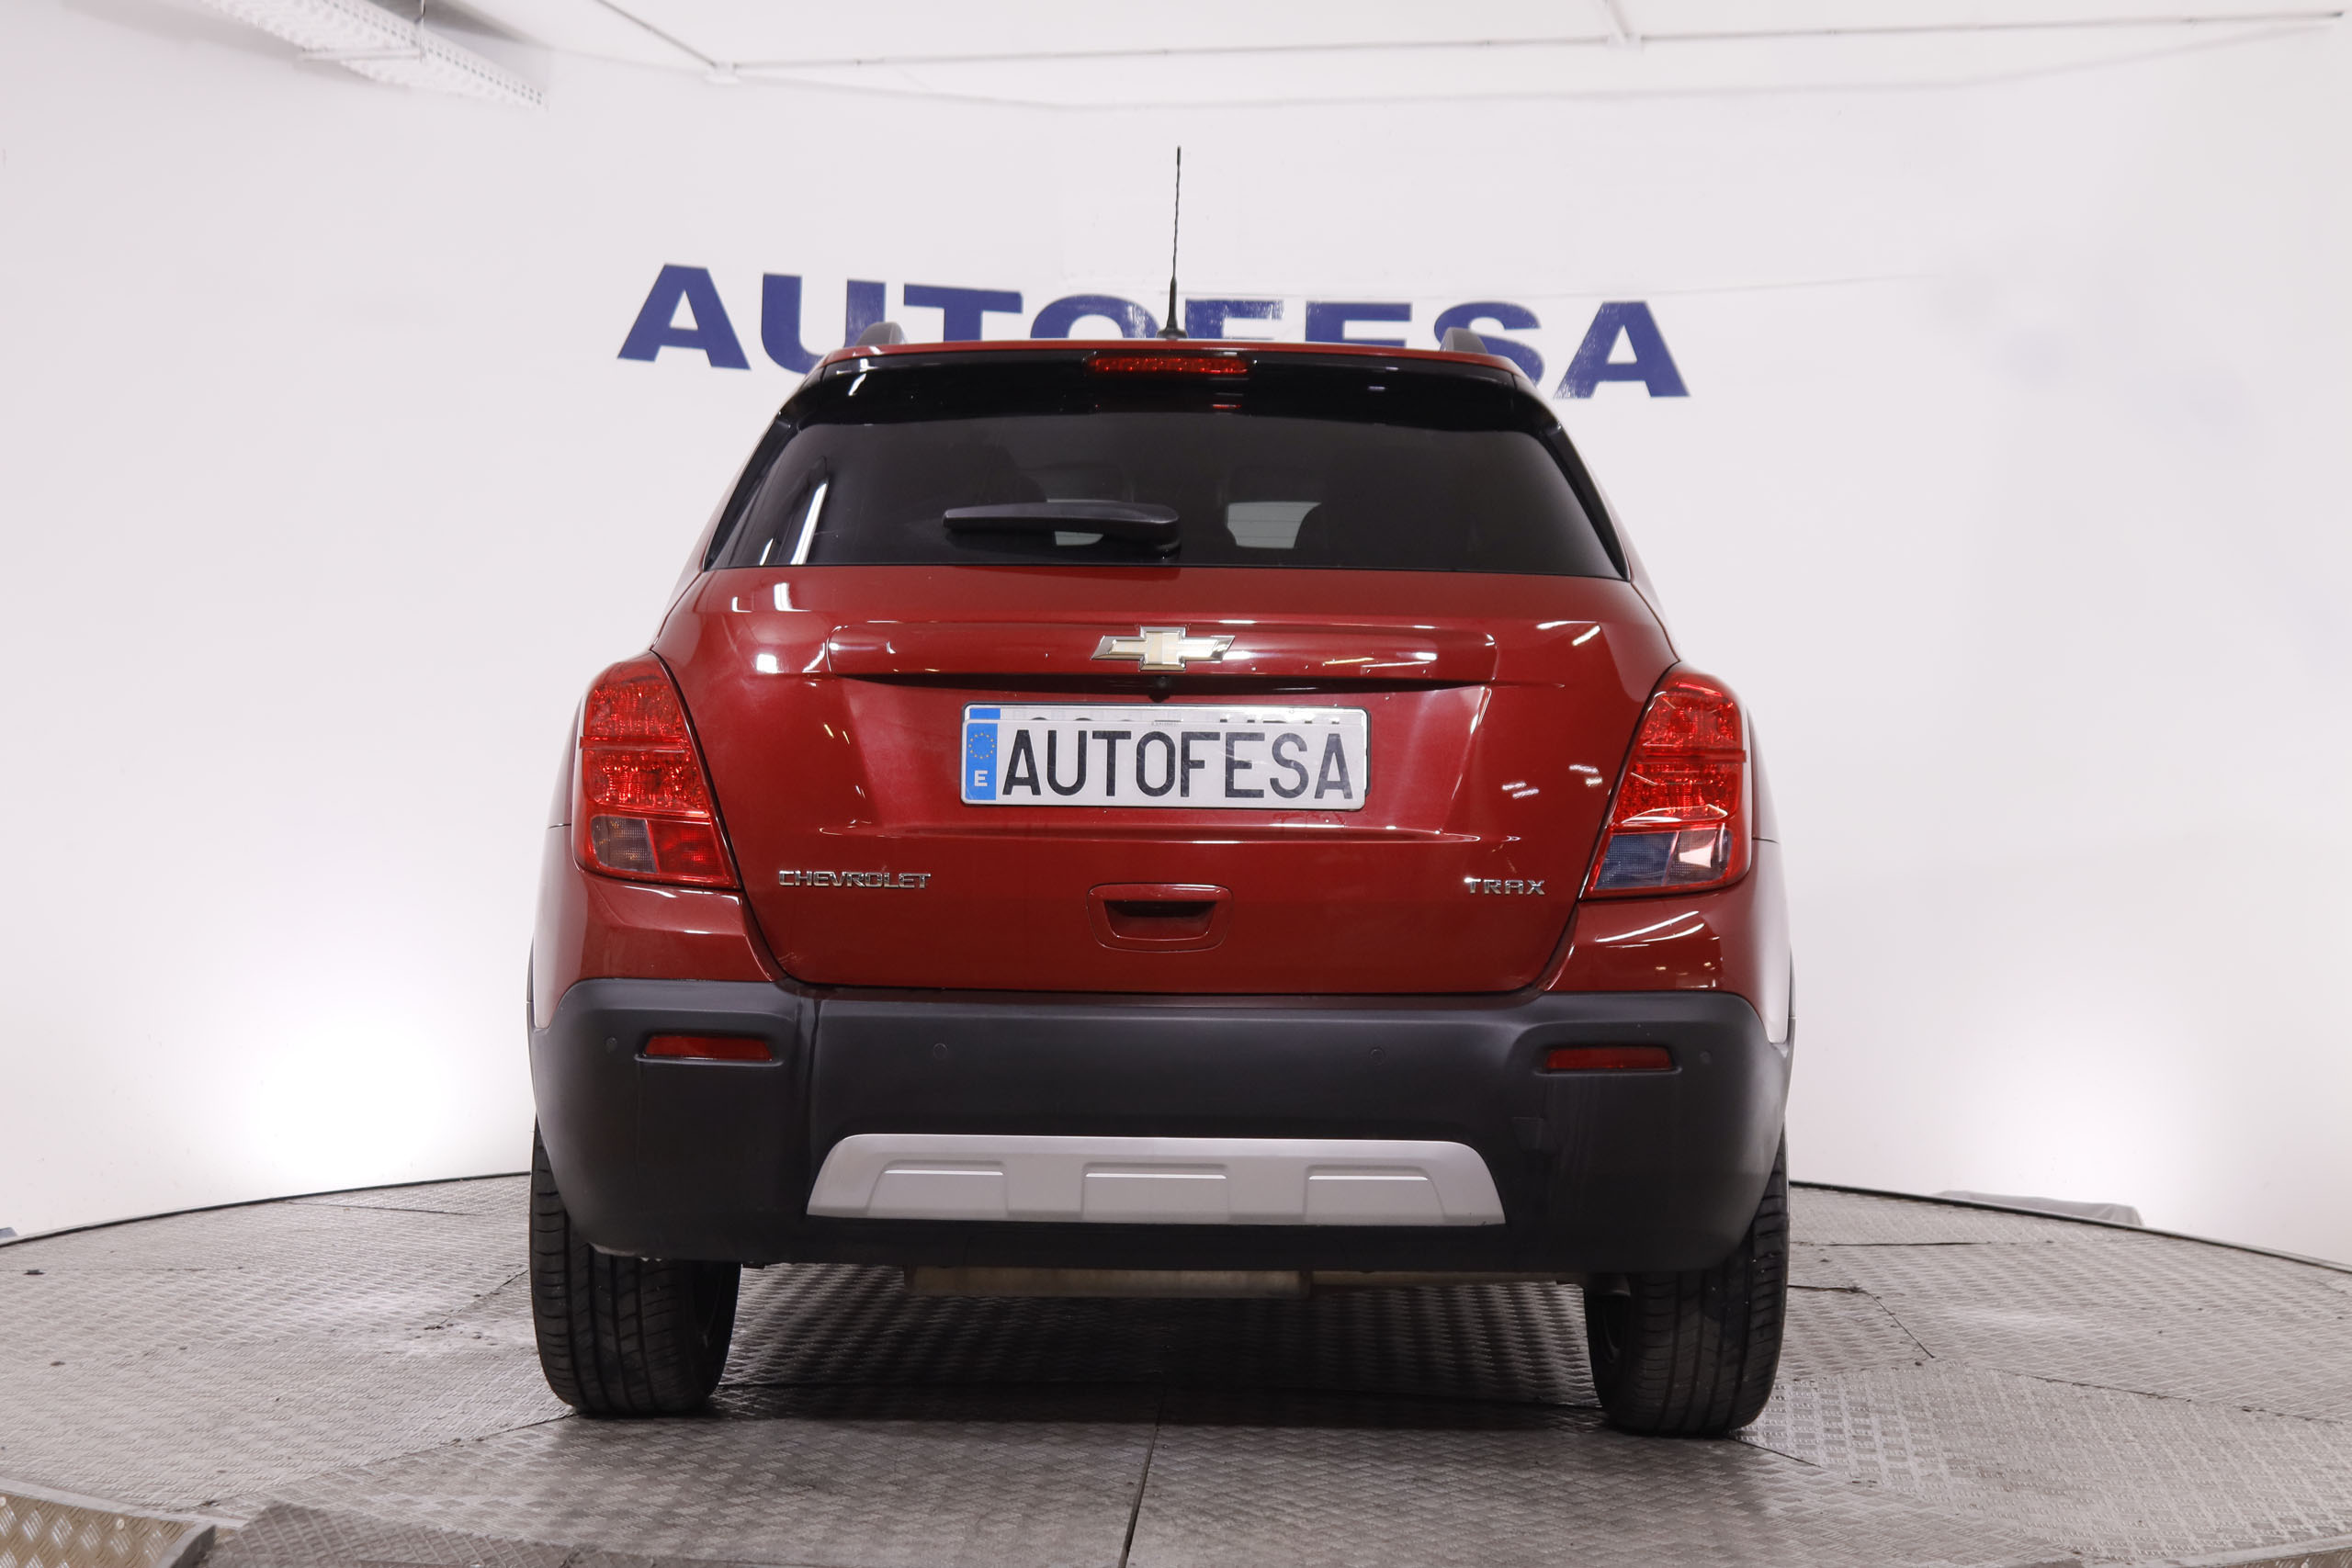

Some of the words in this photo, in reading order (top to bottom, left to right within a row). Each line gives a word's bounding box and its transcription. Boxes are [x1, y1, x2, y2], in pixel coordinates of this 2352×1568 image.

[1001, 729, 1353, 800] AUTOFESA
[974, 770, 988, 787] E
[778, 870, 931, 888] CHEVROLET
[1464, 877, 1545, 895] TRAX
